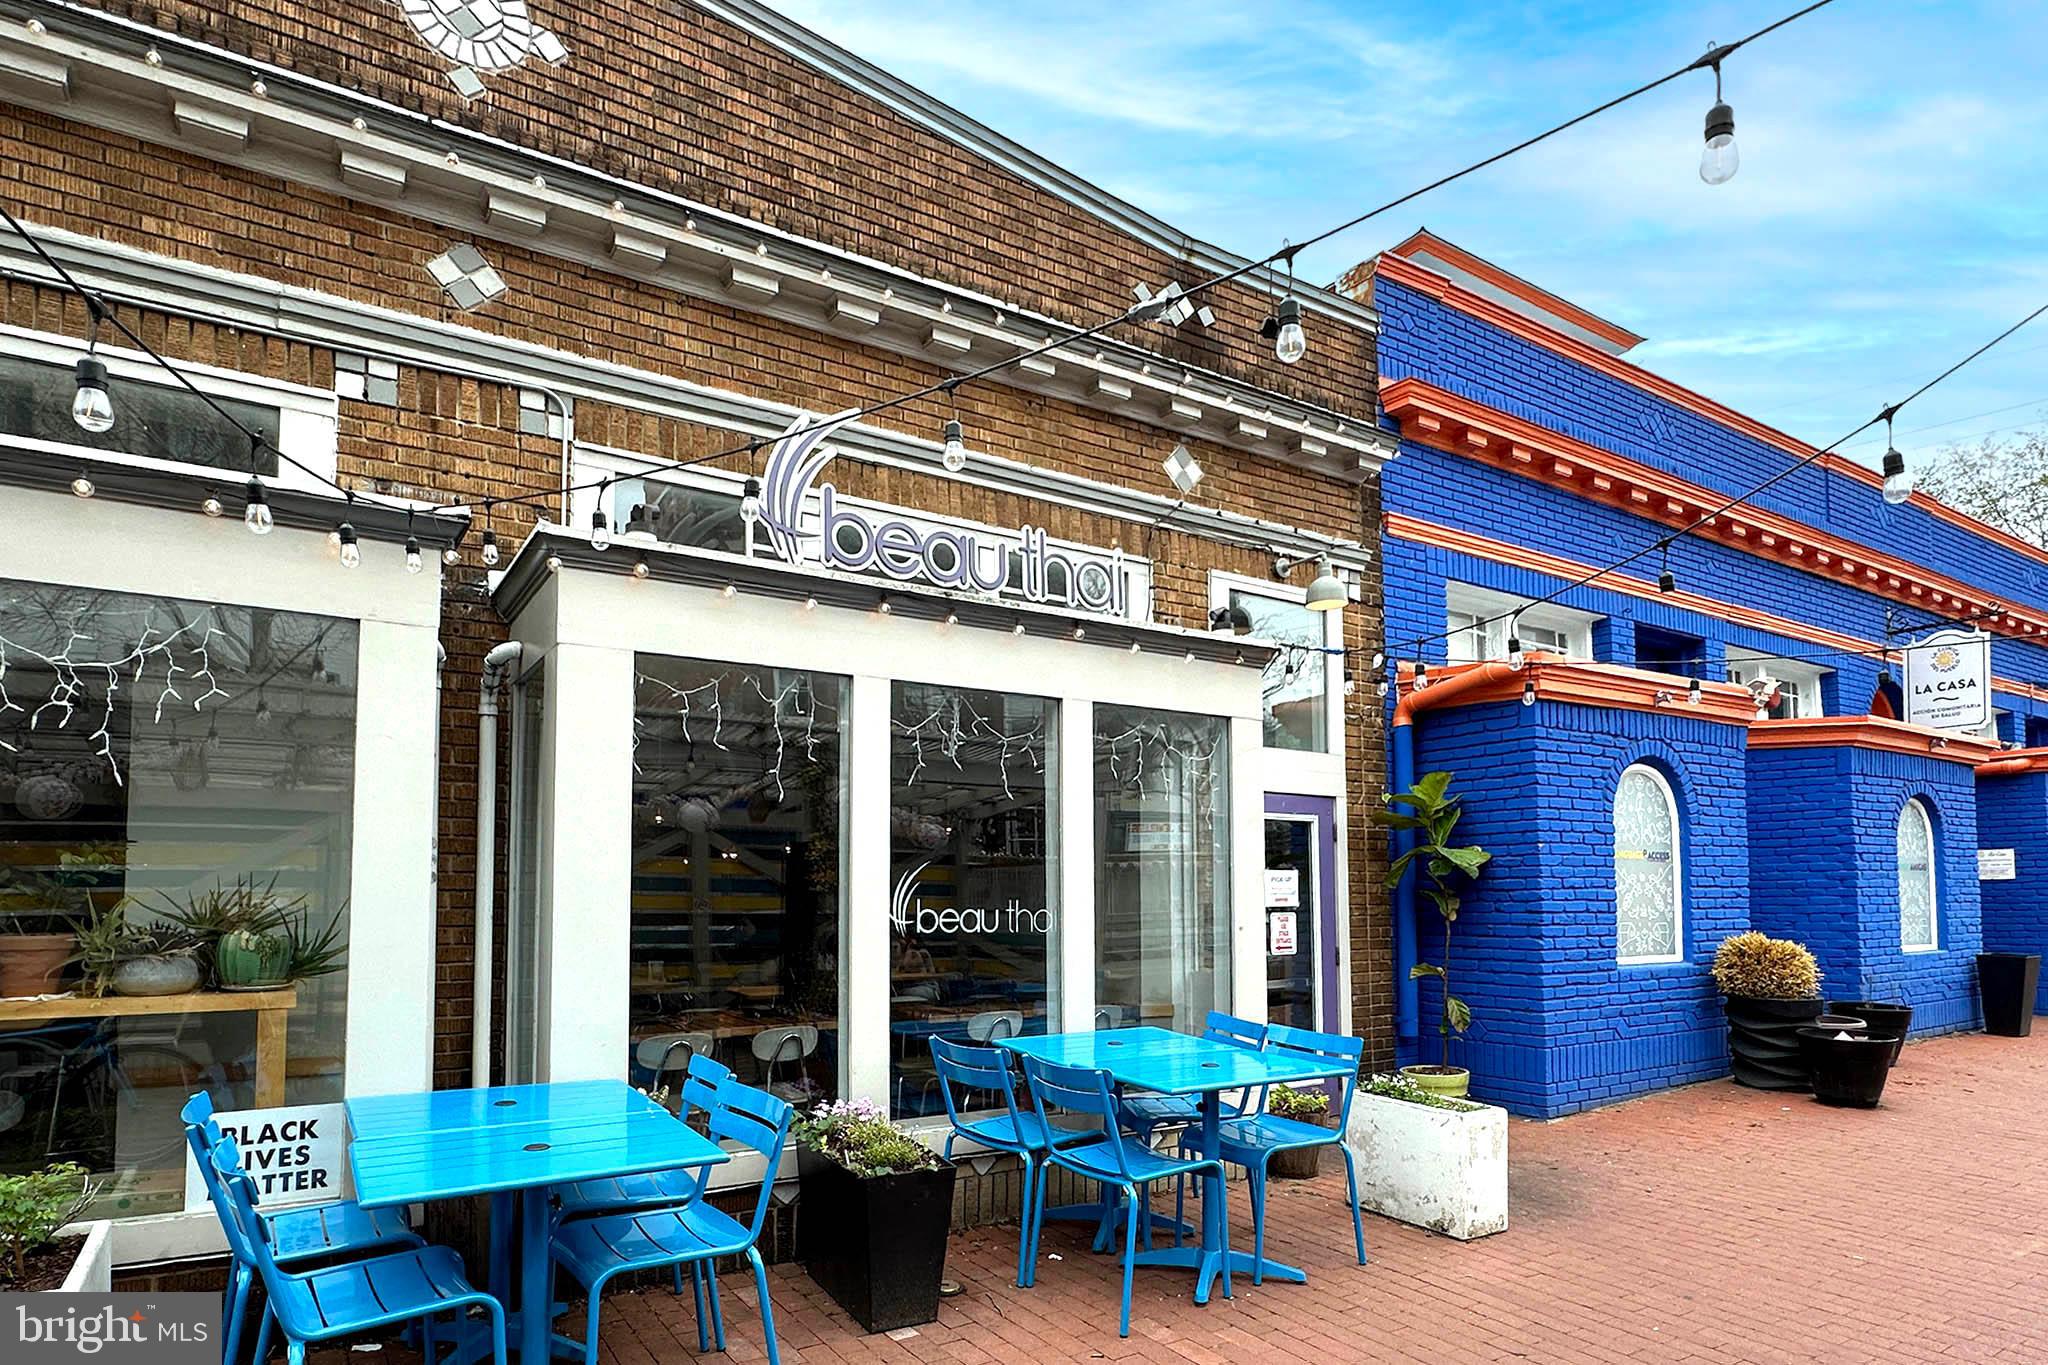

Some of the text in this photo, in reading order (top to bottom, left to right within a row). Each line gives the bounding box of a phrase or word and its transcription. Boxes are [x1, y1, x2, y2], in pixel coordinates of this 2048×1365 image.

[820, 482, 1127, 617] beau thai
[1915, 678, 1977, 695] LA CASA
[916, 898, 999, 933] beau
[221, 1119, 320, 1146] BLACK
[237, 1145, 311, 1171] IVES
[250, 1168, 329, 1195] TTER
